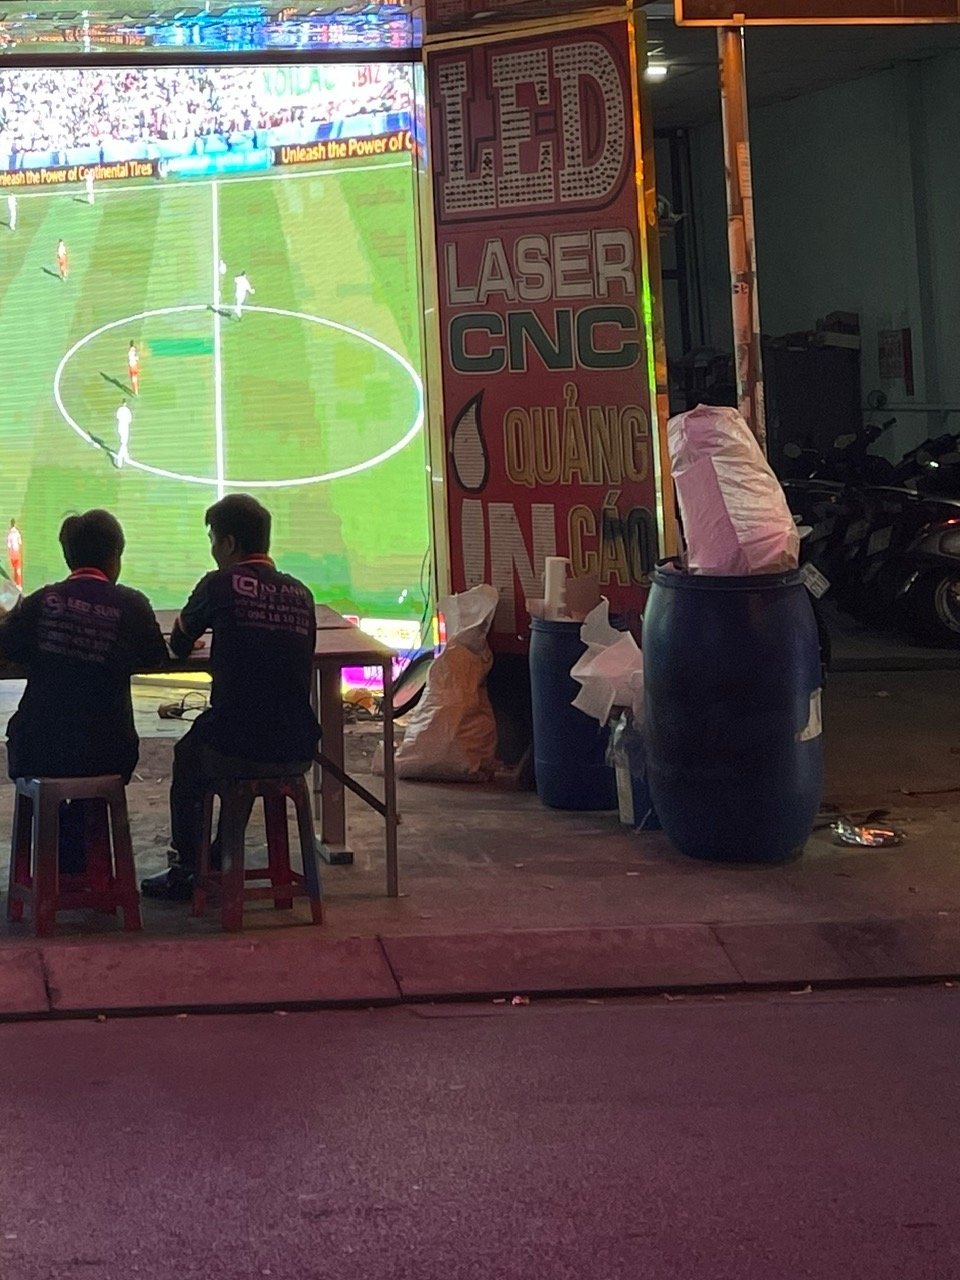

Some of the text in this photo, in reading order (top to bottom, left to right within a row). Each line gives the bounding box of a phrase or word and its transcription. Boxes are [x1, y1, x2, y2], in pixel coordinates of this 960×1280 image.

[281, 144, 326, 165] Unleash
[326, 141, 346, 160] the
[348, 136, 386, 158] Power
[387, 133, 405, 152] of
[439, 40, 626, 214] LED
[444, 227, 637, 307] LASER
[448, 305, 641, 375] CNC
[503, 382, 651, 489] QUẢNG
[568, 489, 660, 588] CÁO
